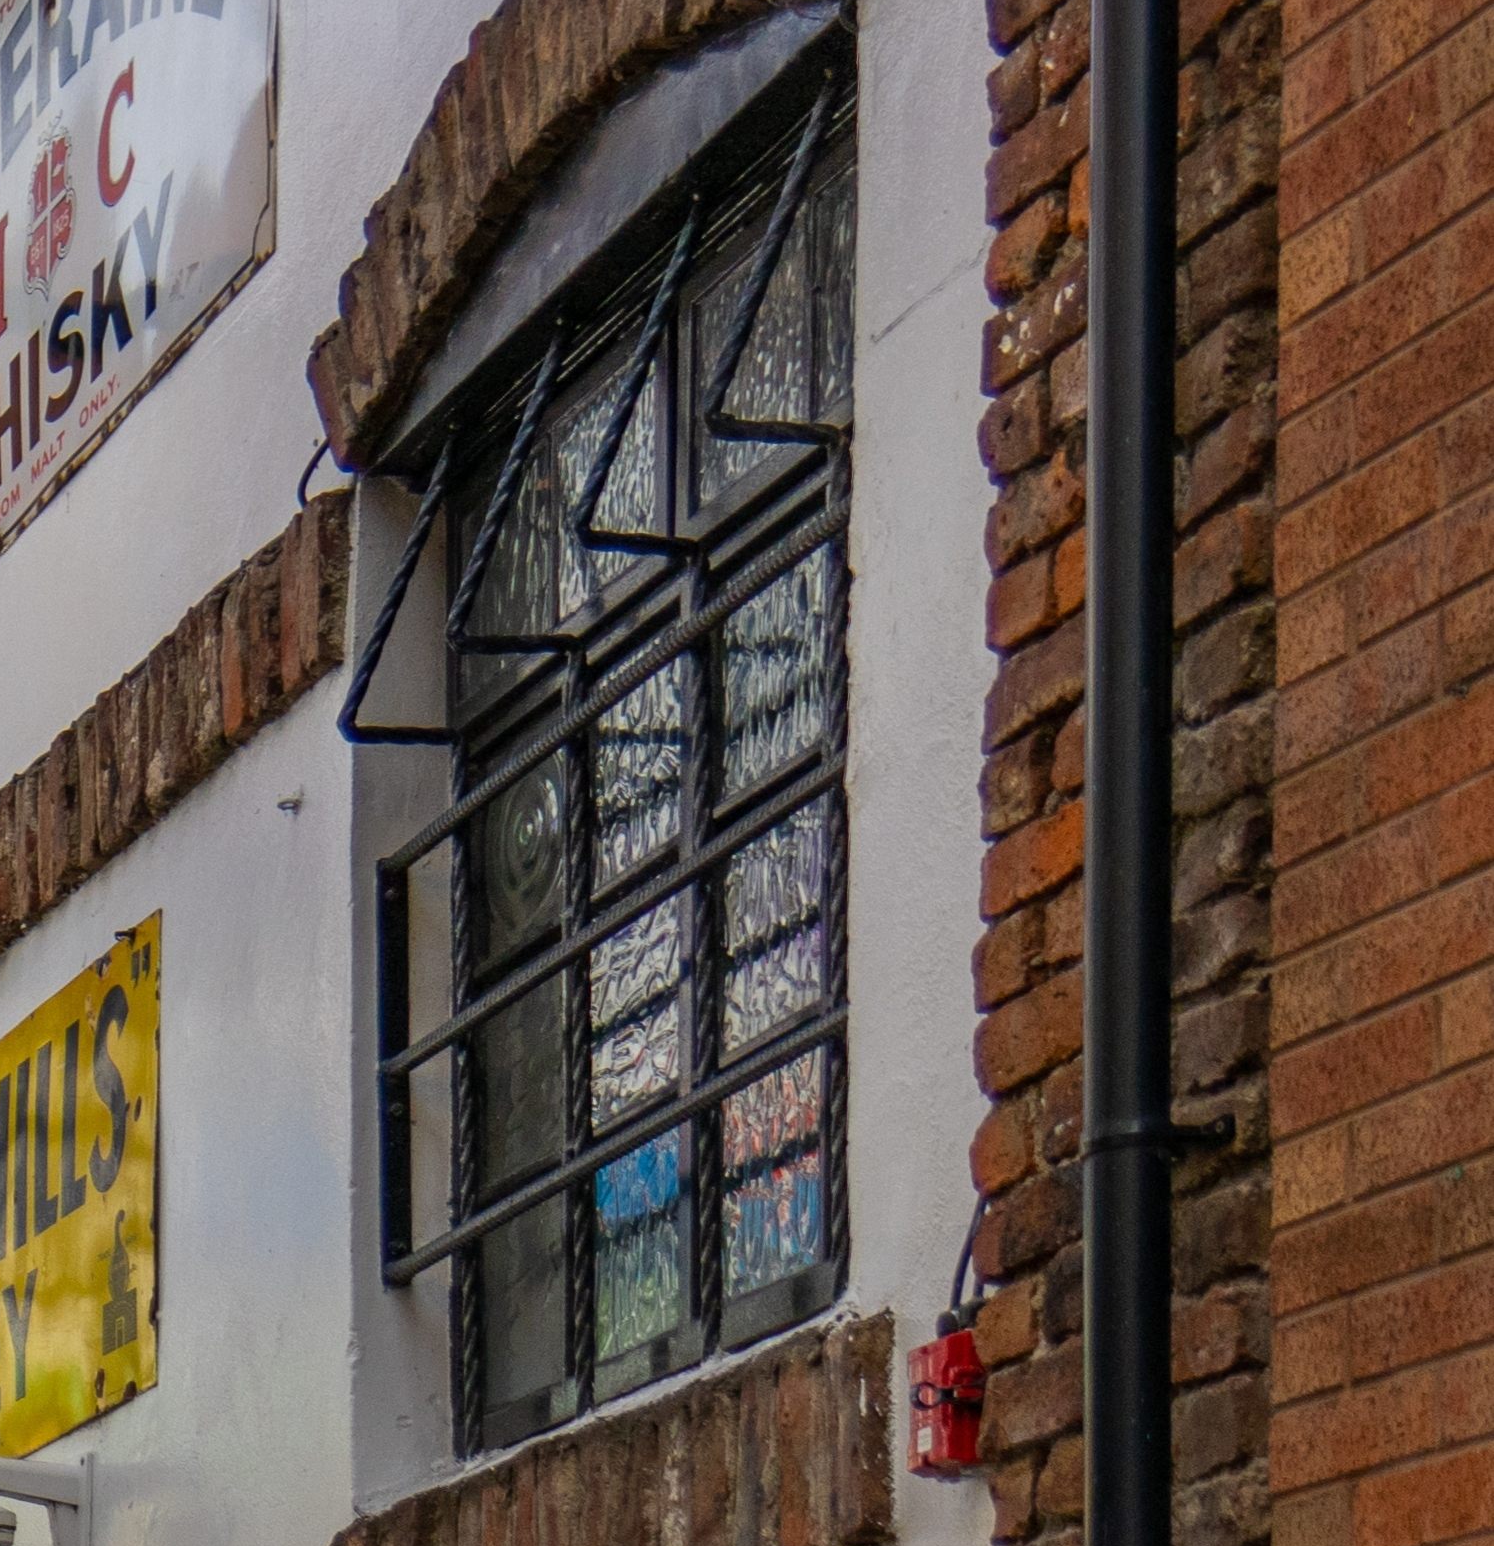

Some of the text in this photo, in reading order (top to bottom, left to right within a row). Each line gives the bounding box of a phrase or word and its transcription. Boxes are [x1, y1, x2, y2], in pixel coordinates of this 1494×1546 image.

[96, 56, 135, 210] C
[29, 430, 66, 491] MALT
[77, 375, 123, 430] ONLY.
